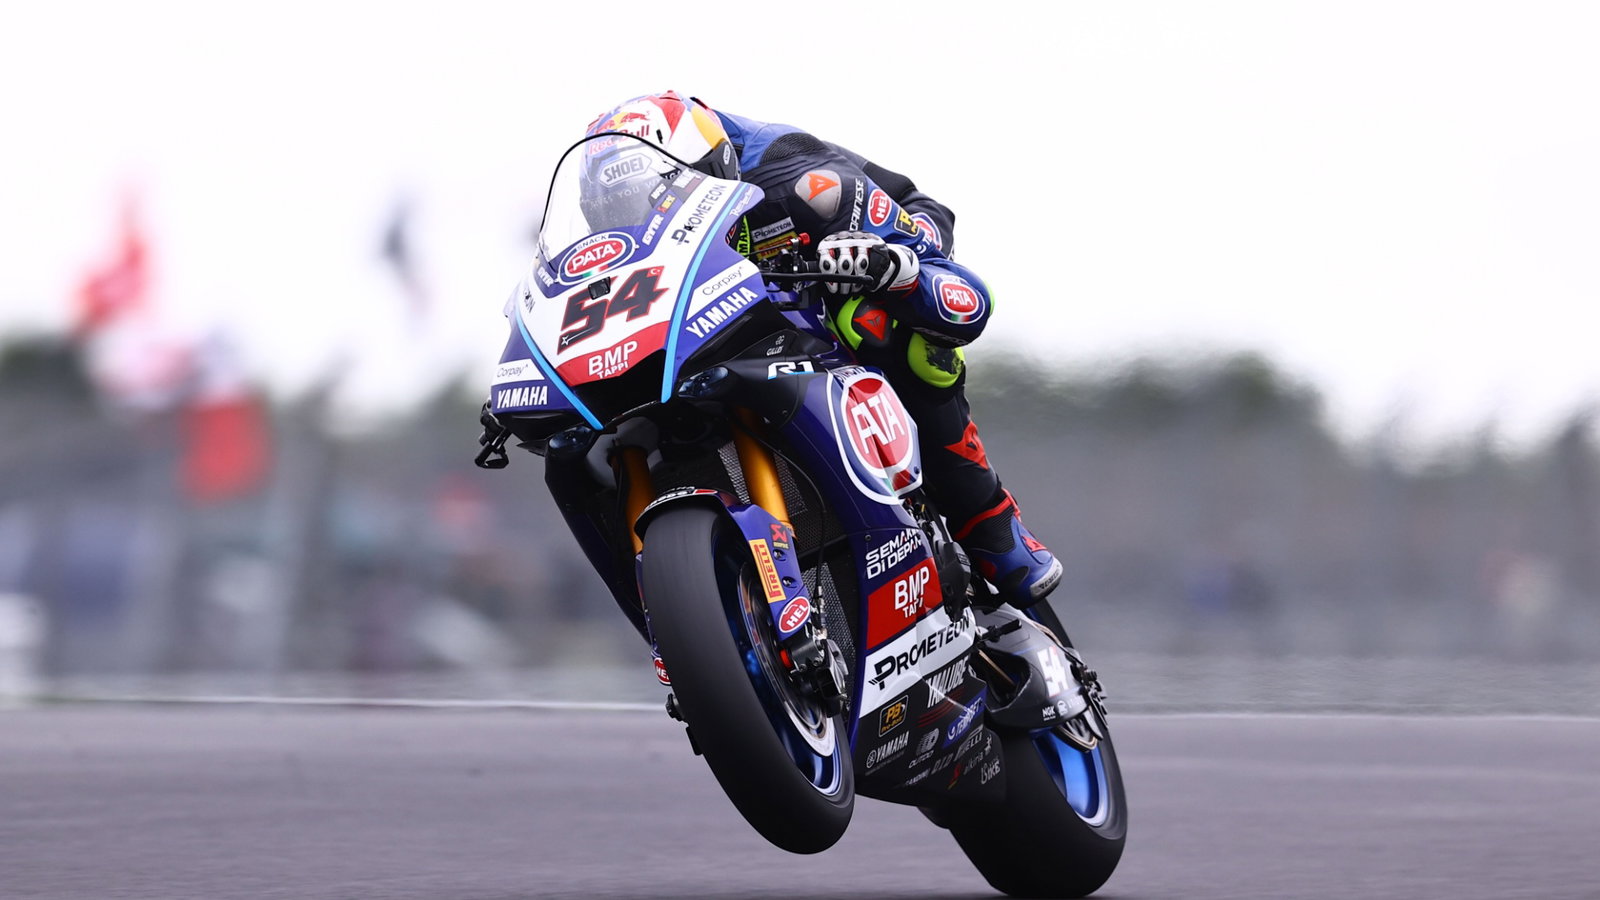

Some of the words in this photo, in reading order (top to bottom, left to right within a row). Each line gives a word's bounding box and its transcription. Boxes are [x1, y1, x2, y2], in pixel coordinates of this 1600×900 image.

[603, 157, 645, 182] SHOEI
[671, 184, 728, 246] PROMETEON
[850, 178, 865, 231] DAINESE
[576, 234, 608, 251] SNACK
[571, 243, 617, 271] PATA
[702, 268, 743, 296] Corpay
[557, 266, 669, 355] 54
[944, 287, 974, 307] PATA
[686, 286, 758, 338] YAMAHA
[497, 365, 524, 378] Corpay
[588, 341, 638, 376] BMP
[597, 362, 628, 379] TAPPI
[767, 361, 816, 380] R1
[497, 386, 548, 409] YAMAHA
[850, 392, 905, 455] PATA
[754, 544, 783, 598] PIRELLI
[866, 560, 886, 579] DI
[894, 566, 930, 610] BMP
[786, 604, 809, 627] HEL
[1042, 706, 1056, 718] NGK
[876, 730, 910, 763] YAMAHA
